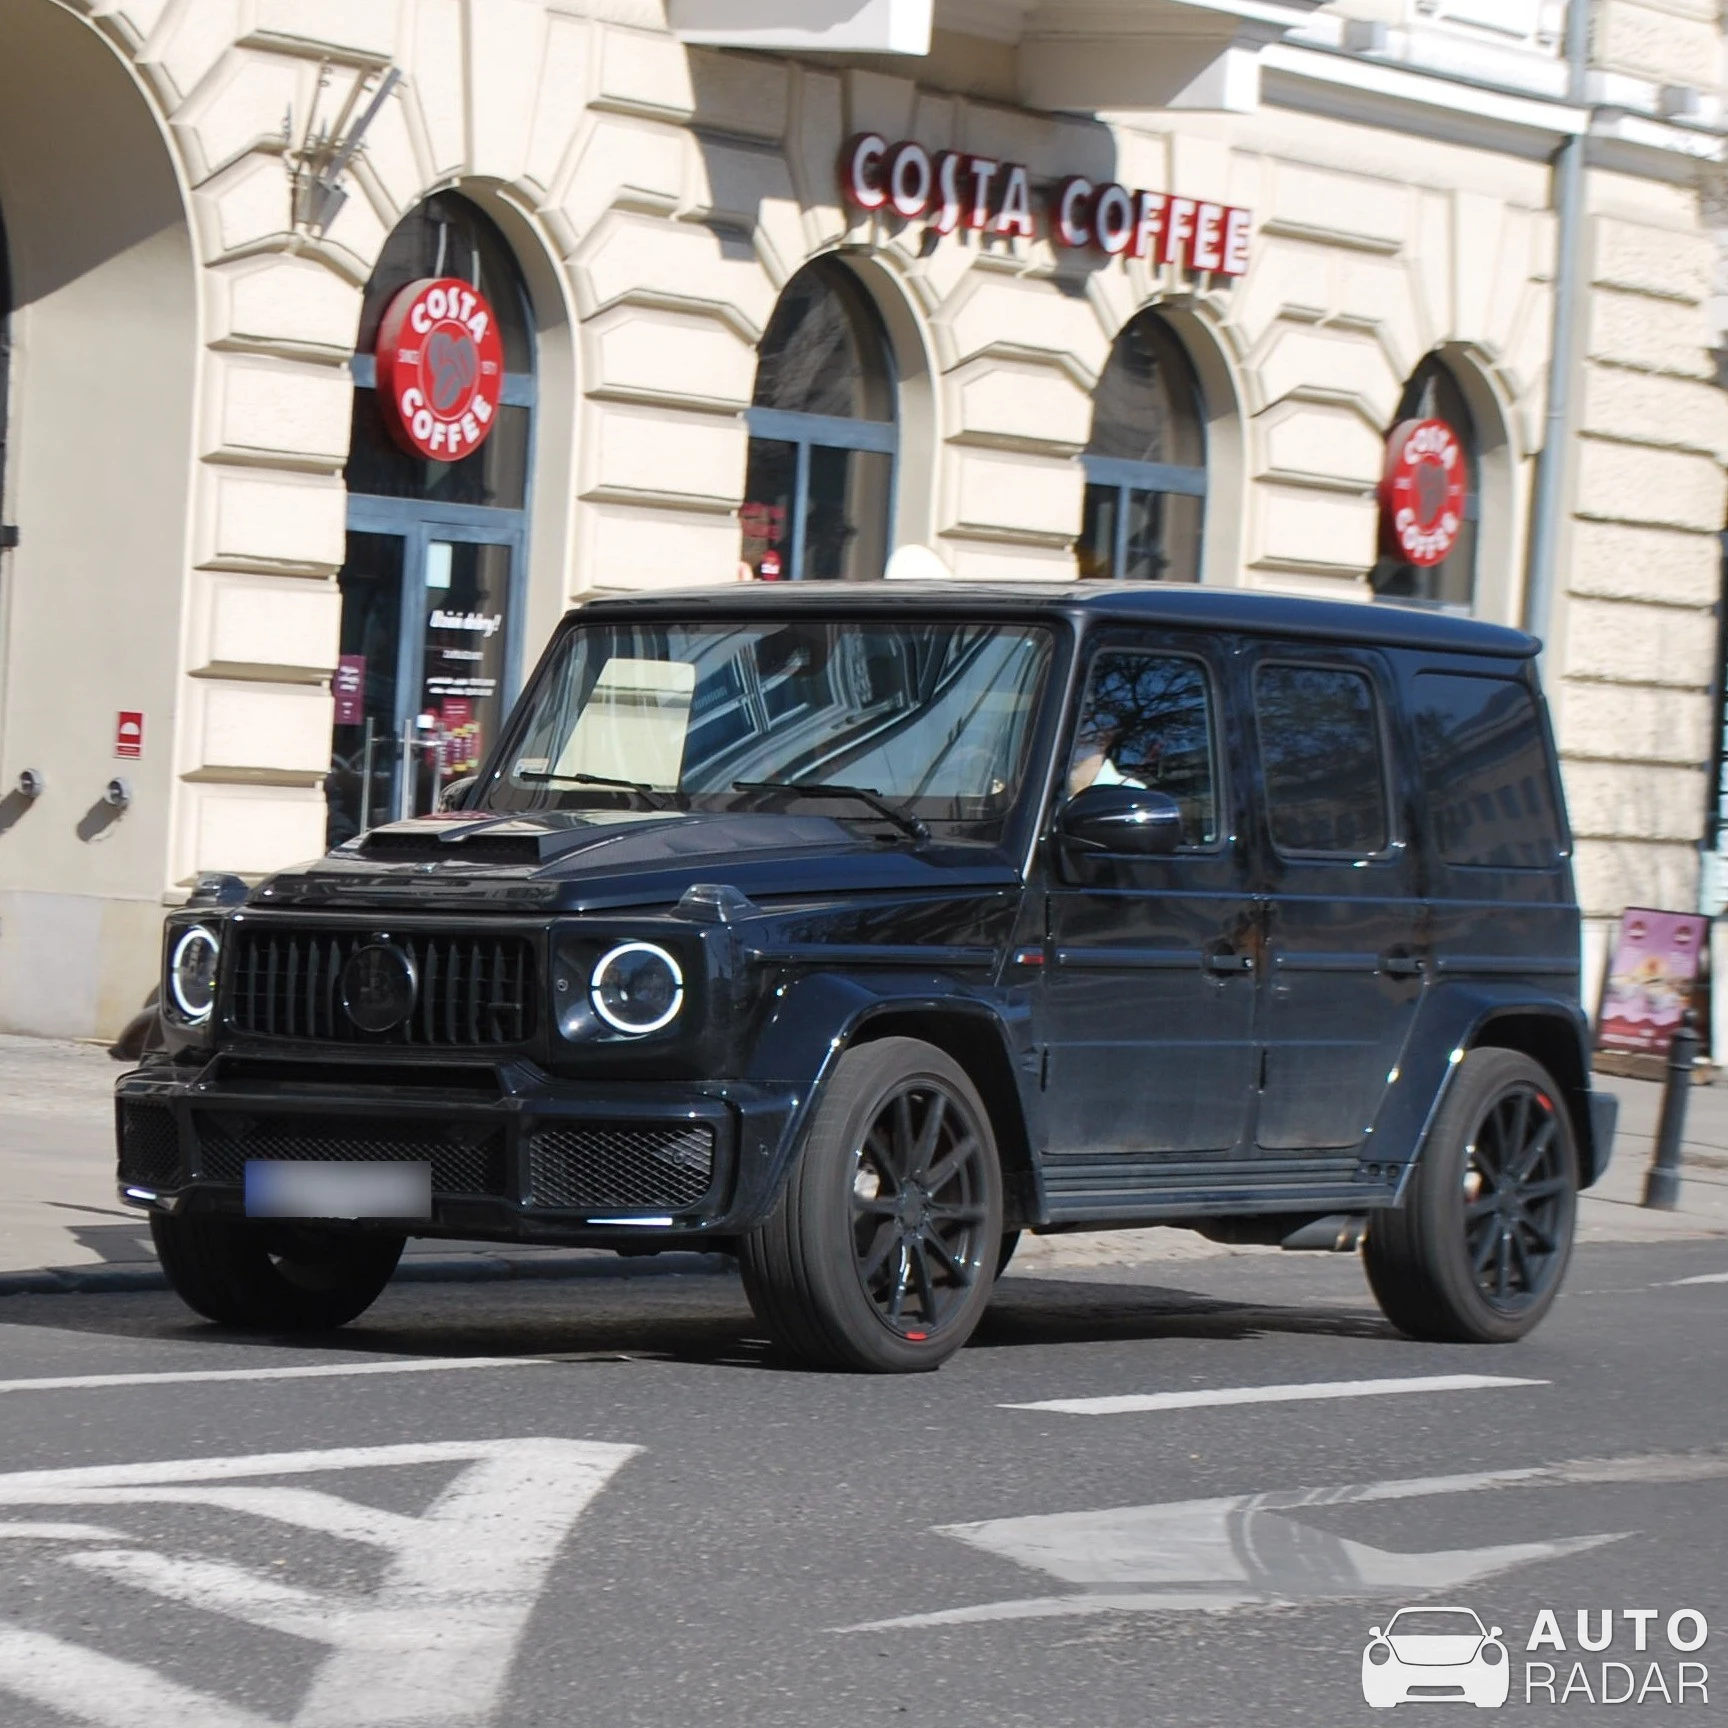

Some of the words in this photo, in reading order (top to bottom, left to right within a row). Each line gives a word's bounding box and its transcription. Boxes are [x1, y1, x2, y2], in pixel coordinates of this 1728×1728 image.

[849, 133, 1034, 236] COSTA
[1059, 176, 1251, 275] COFFEE
[411, 286, 489, 344] COSTA
[402, 387, 492, 453] COFFEE
